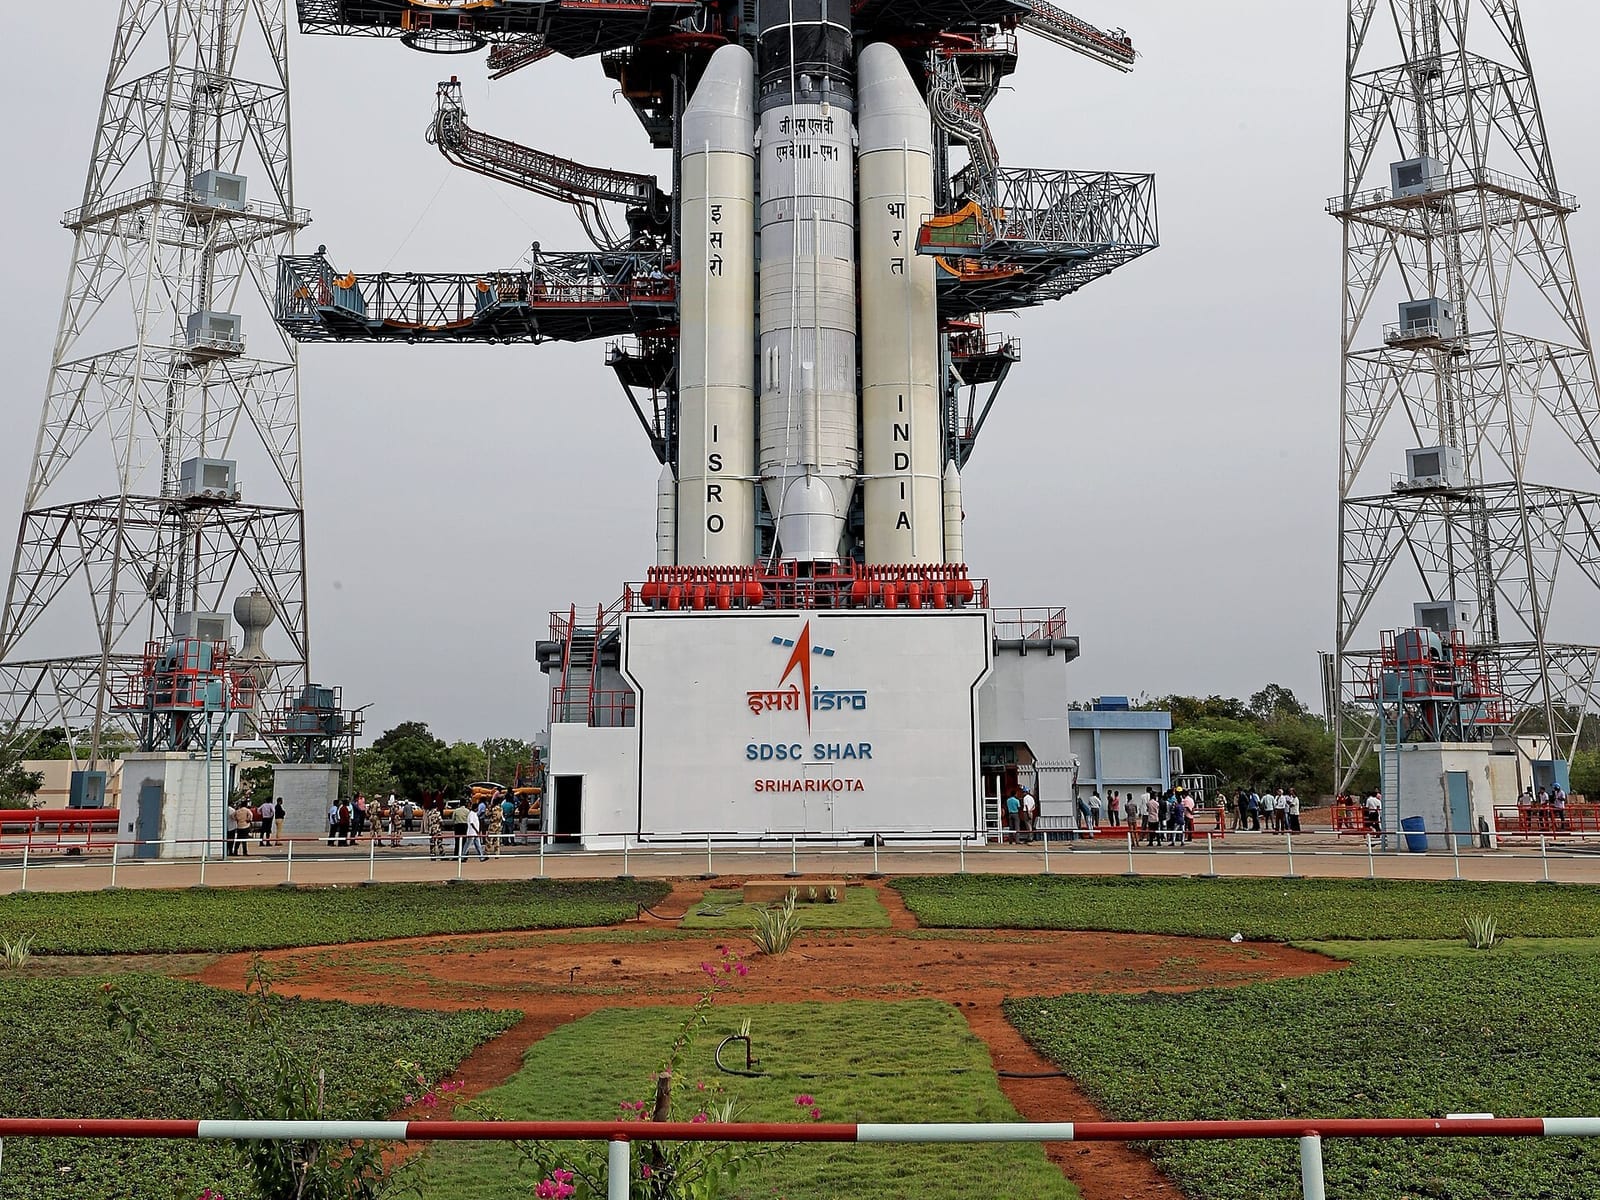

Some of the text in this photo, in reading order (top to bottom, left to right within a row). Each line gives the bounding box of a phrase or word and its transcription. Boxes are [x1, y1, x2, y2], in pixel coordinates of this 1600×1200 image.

[709, 204, 723, 276] इसरो
[887, 203, 905, 274] भारत
[707, 424, 724, 533] ISRO
[893, 394, 911, 530] INDIA
[746, 684, 800, 715] इसरो
[746, 742, 873, 761] SDSC SHAR
[754, 779, 865, 792] SRIHARIKOTA
